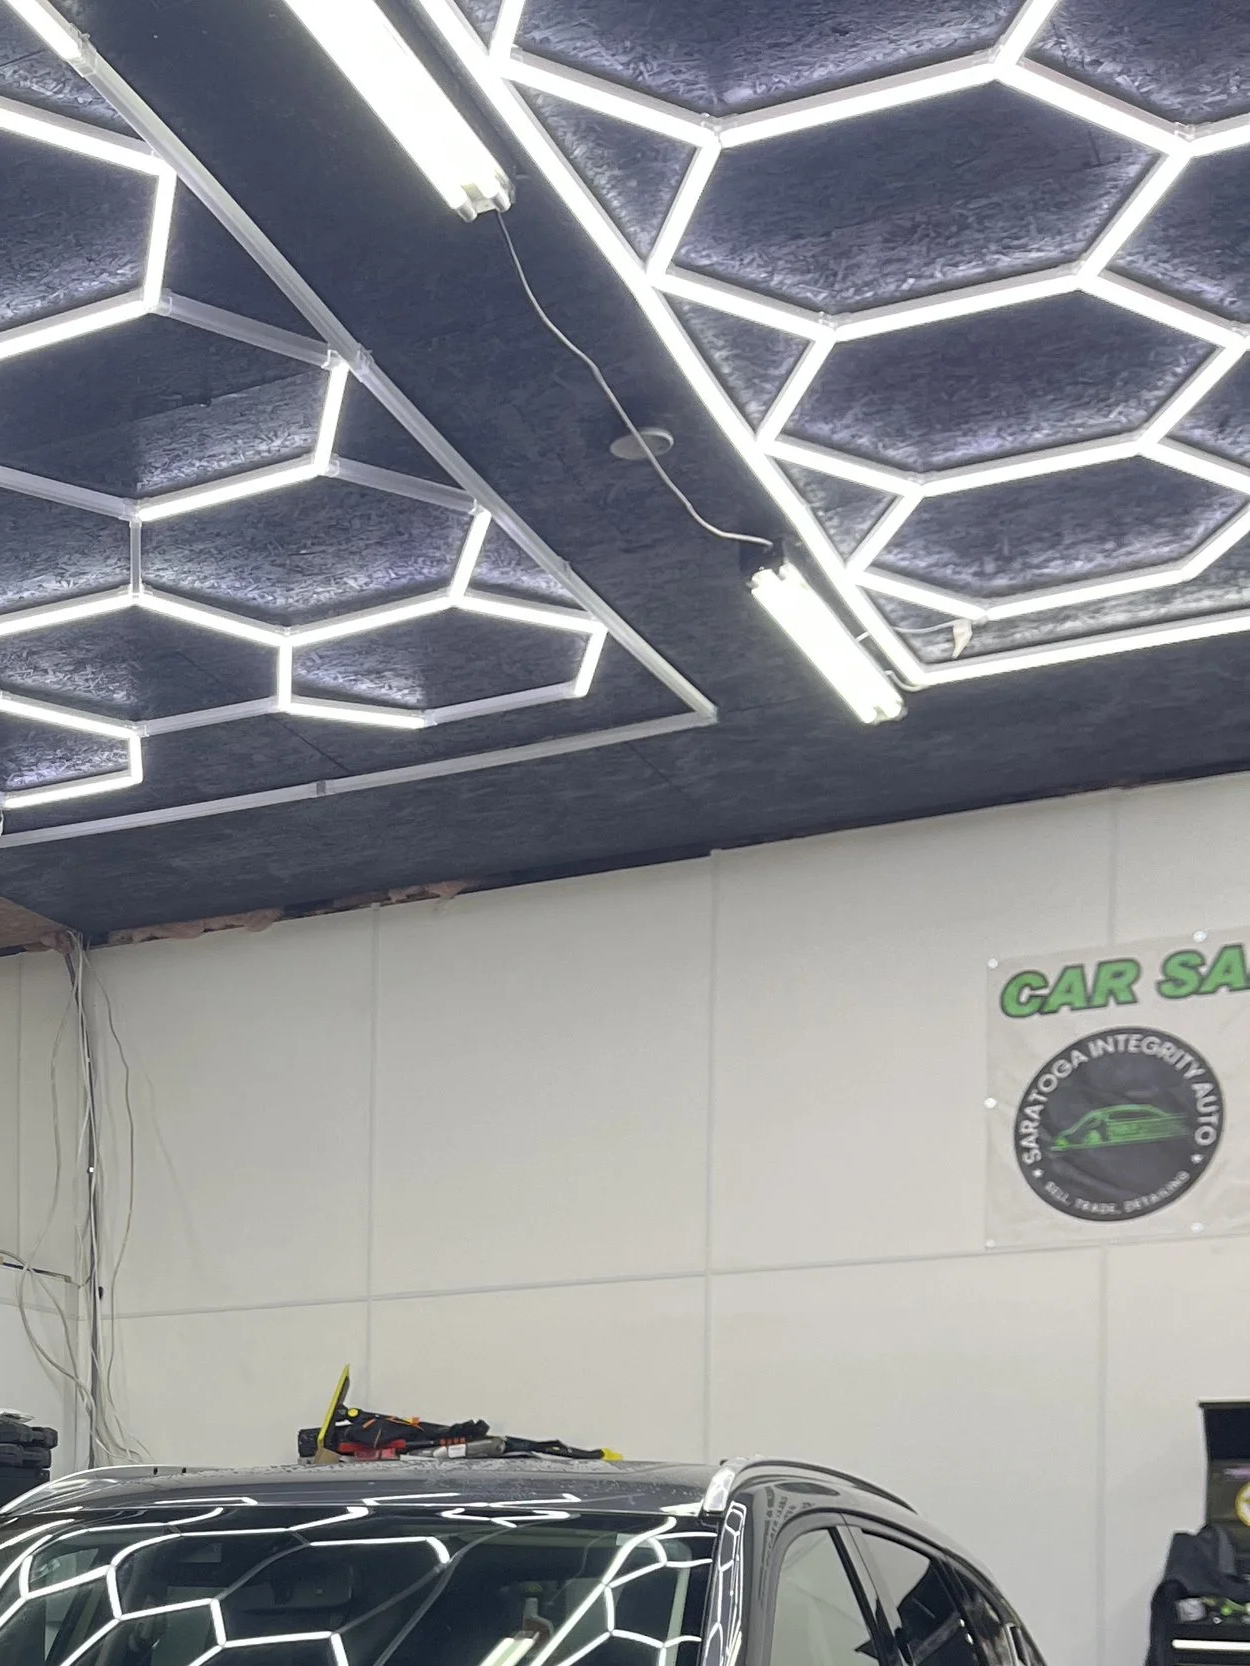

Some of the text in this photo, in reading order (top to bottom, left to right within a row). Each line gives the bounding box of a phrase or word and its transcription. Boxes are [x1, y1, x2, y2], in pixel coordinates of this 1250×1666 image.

[1000, 943, 1250, 1018] CAR SA
[1021, 1032, 1218, 1165] SARATOGA INTEGRITY AUTO
